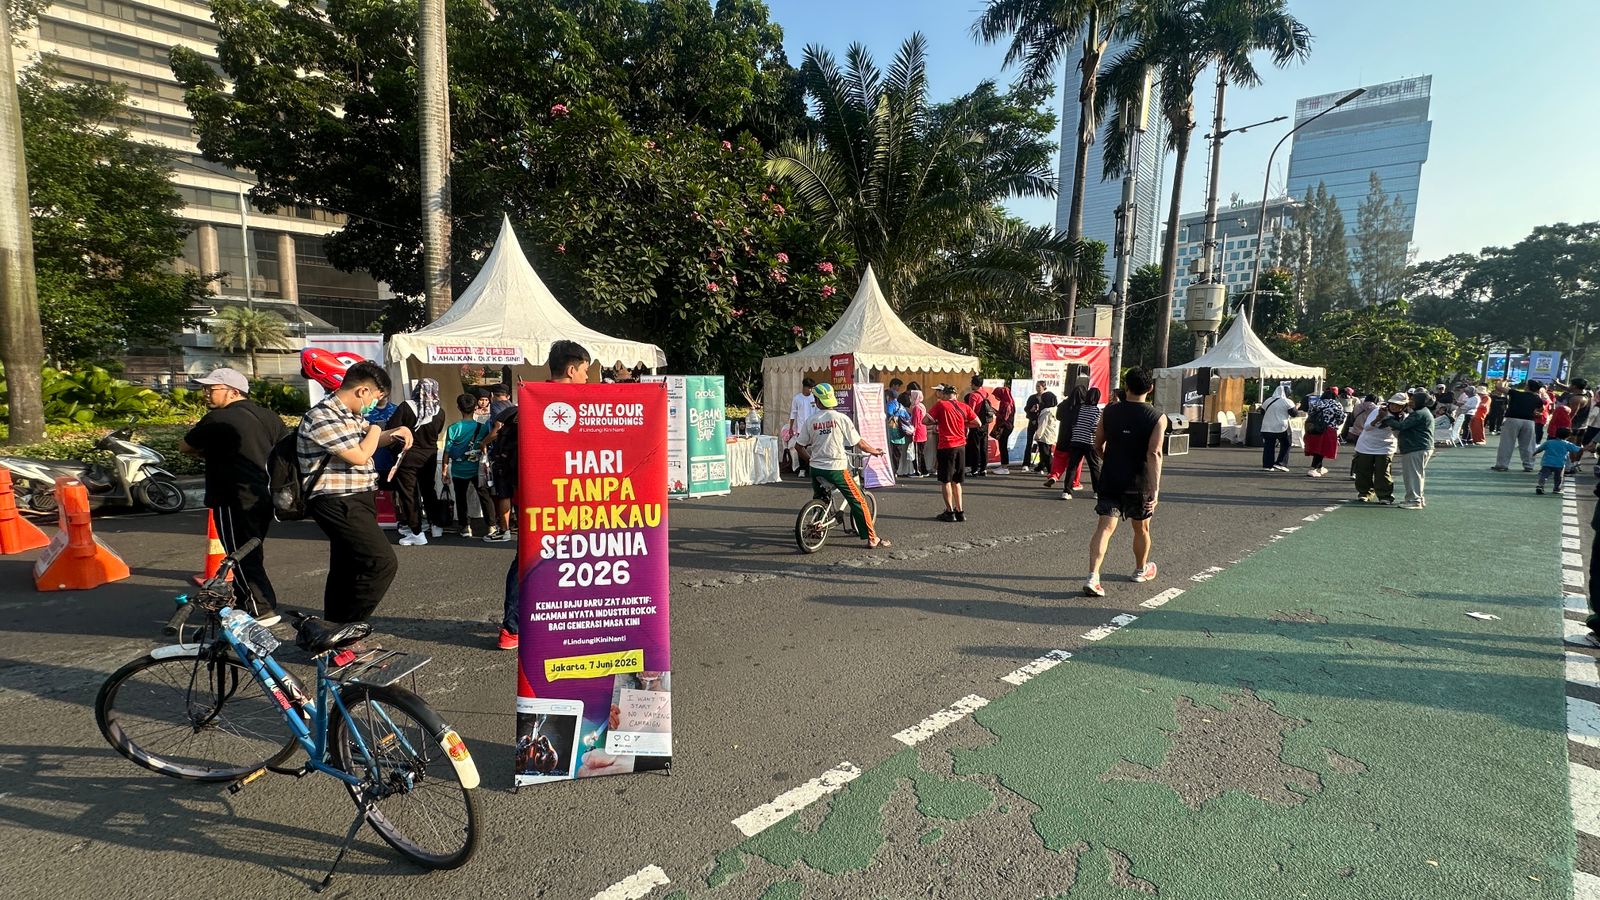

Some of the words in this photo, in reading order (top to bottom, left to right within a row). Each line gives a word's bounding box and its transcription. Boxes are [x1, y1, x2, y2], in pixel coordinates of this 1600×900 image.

[579, 403, 613, 417] SAVE
[615, 403, 644, 417] OUR
[579, 417, 644, 426] SURROUNDINGS
[565, 449, 623, 475] HARI
[552, 476, 636, 503] TANPA
[525, 503, 661, 532] TEMBAKAU
[540, 531, 648, 560] SEDUNIA
[558, 559, 630, 588] 2026
[535, 601, 563, 611] KENALI
[563, 600, 583, 609] BAJU
[583, 599, 603, 608] BARU
[604, 598, 620, 607] ZAT
[621, 596, 652, 606] ADIKTIF:
[530, 612, 567, 621] ANCAMAN
[568, 610, 594, 619] NYATA
[595, 607, 629, 618] INDUSTRI
[630, 605, 657, 615] ROKOK
[548, 622, 566, 632] BAGI
[566, 620, 602, 630] GENERASI
[603, 618, 623, 628] MASA
[624, 617, 640, 626] KINI
[562, 634, 627, 646] #LindungiKiniNanti
[551, 663, 587, 673] Jakarta,
[589, 661, 594, 669] 7
[596, 660, 613, 669] Juni
[614, 658, 637, 667] 2026
[643, 711, 671, 719] VAPING
